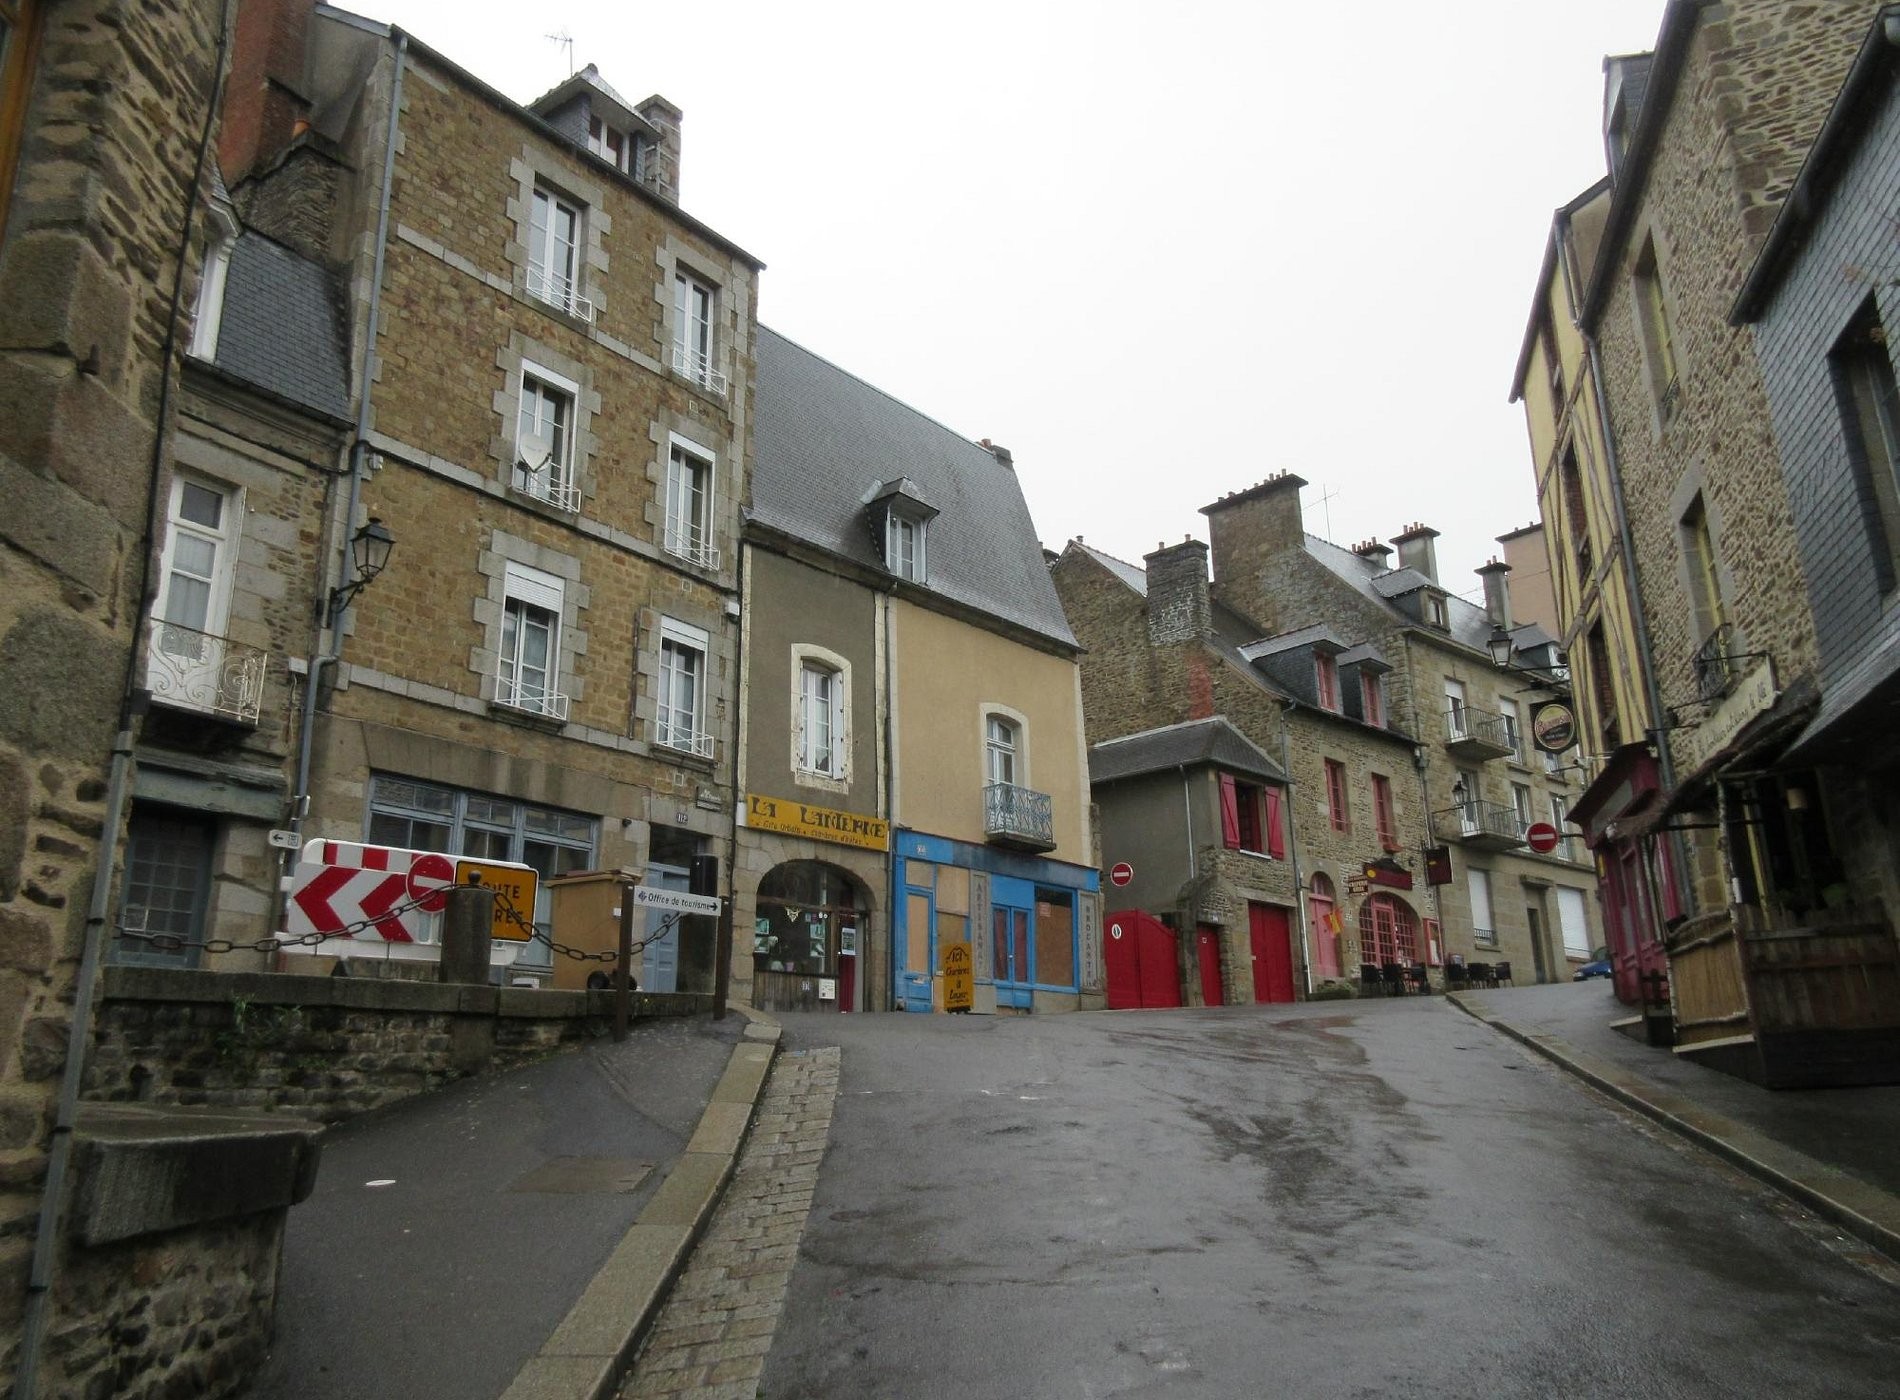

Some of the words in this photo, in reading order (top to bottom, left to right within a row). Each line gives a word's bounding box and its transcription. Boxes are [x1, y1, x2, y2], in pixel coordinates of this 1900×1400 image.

[648, 893, 670, 905] Office
[671, 897, 680, 906] de
[681, 899, 710, 910] tourisme
